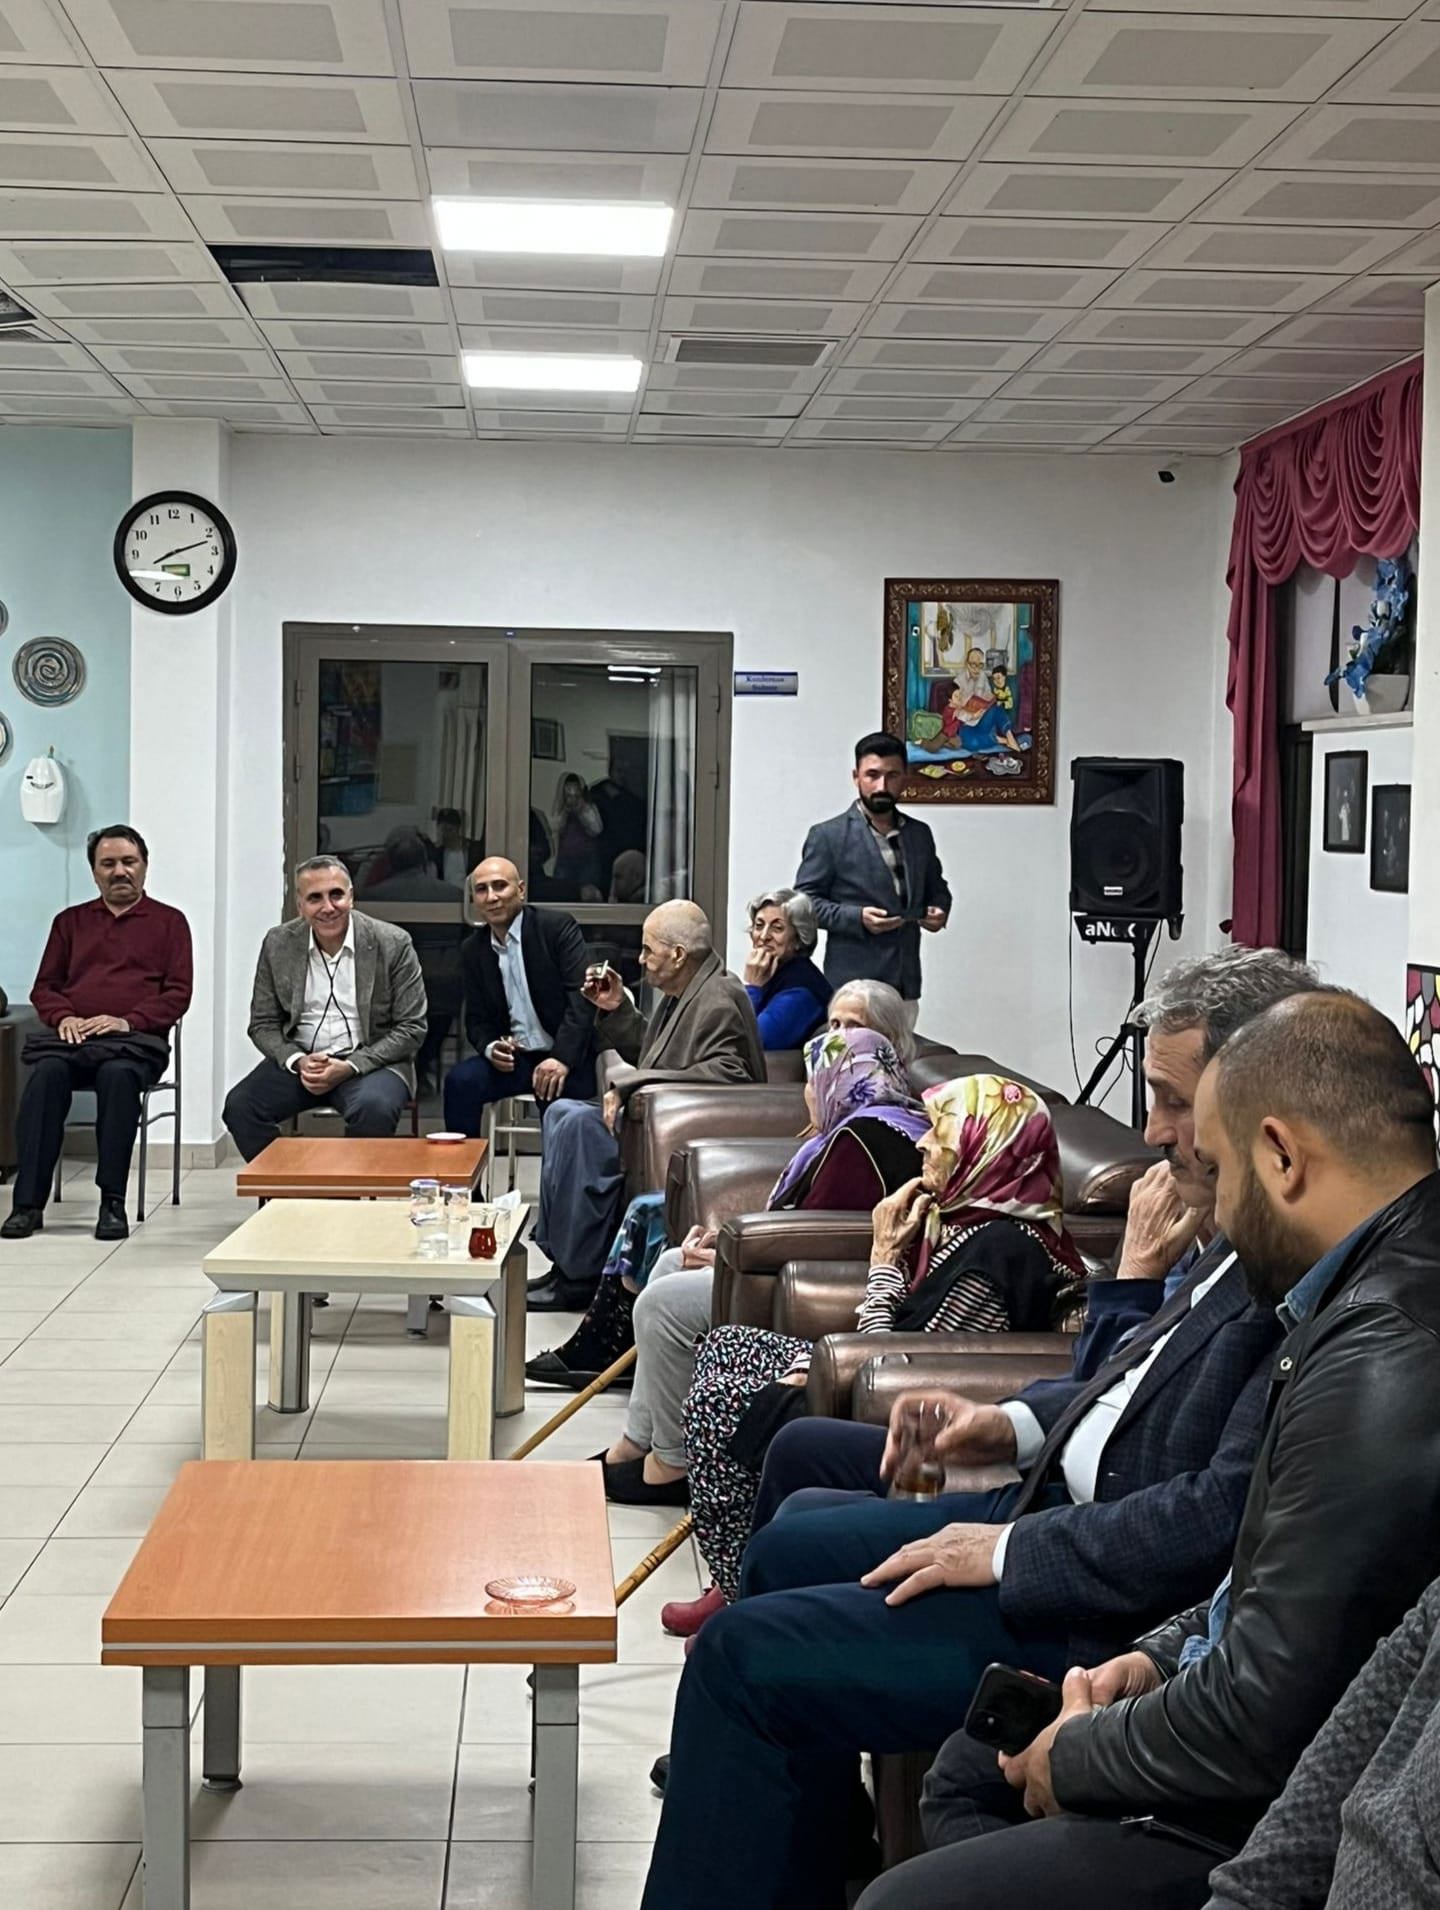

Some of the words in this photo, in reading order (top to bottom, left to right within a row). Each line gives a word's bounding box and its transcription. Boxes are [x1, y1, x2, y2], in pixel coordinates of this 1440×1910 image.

[168, 509, 180, 519] 12
[150, 514, 160, 525] 11
[135, 530, 148, 540] 10
[205, 527, 213, 538] 2
[131, 549, 139, 559] 9
[211, 545, 219, 556] 3
[207, 565, 214, 575] 4
[154, 581, 161, 592] 7
[194, 581, 201, 591] 5
[174, 586, 182, 597] 6
